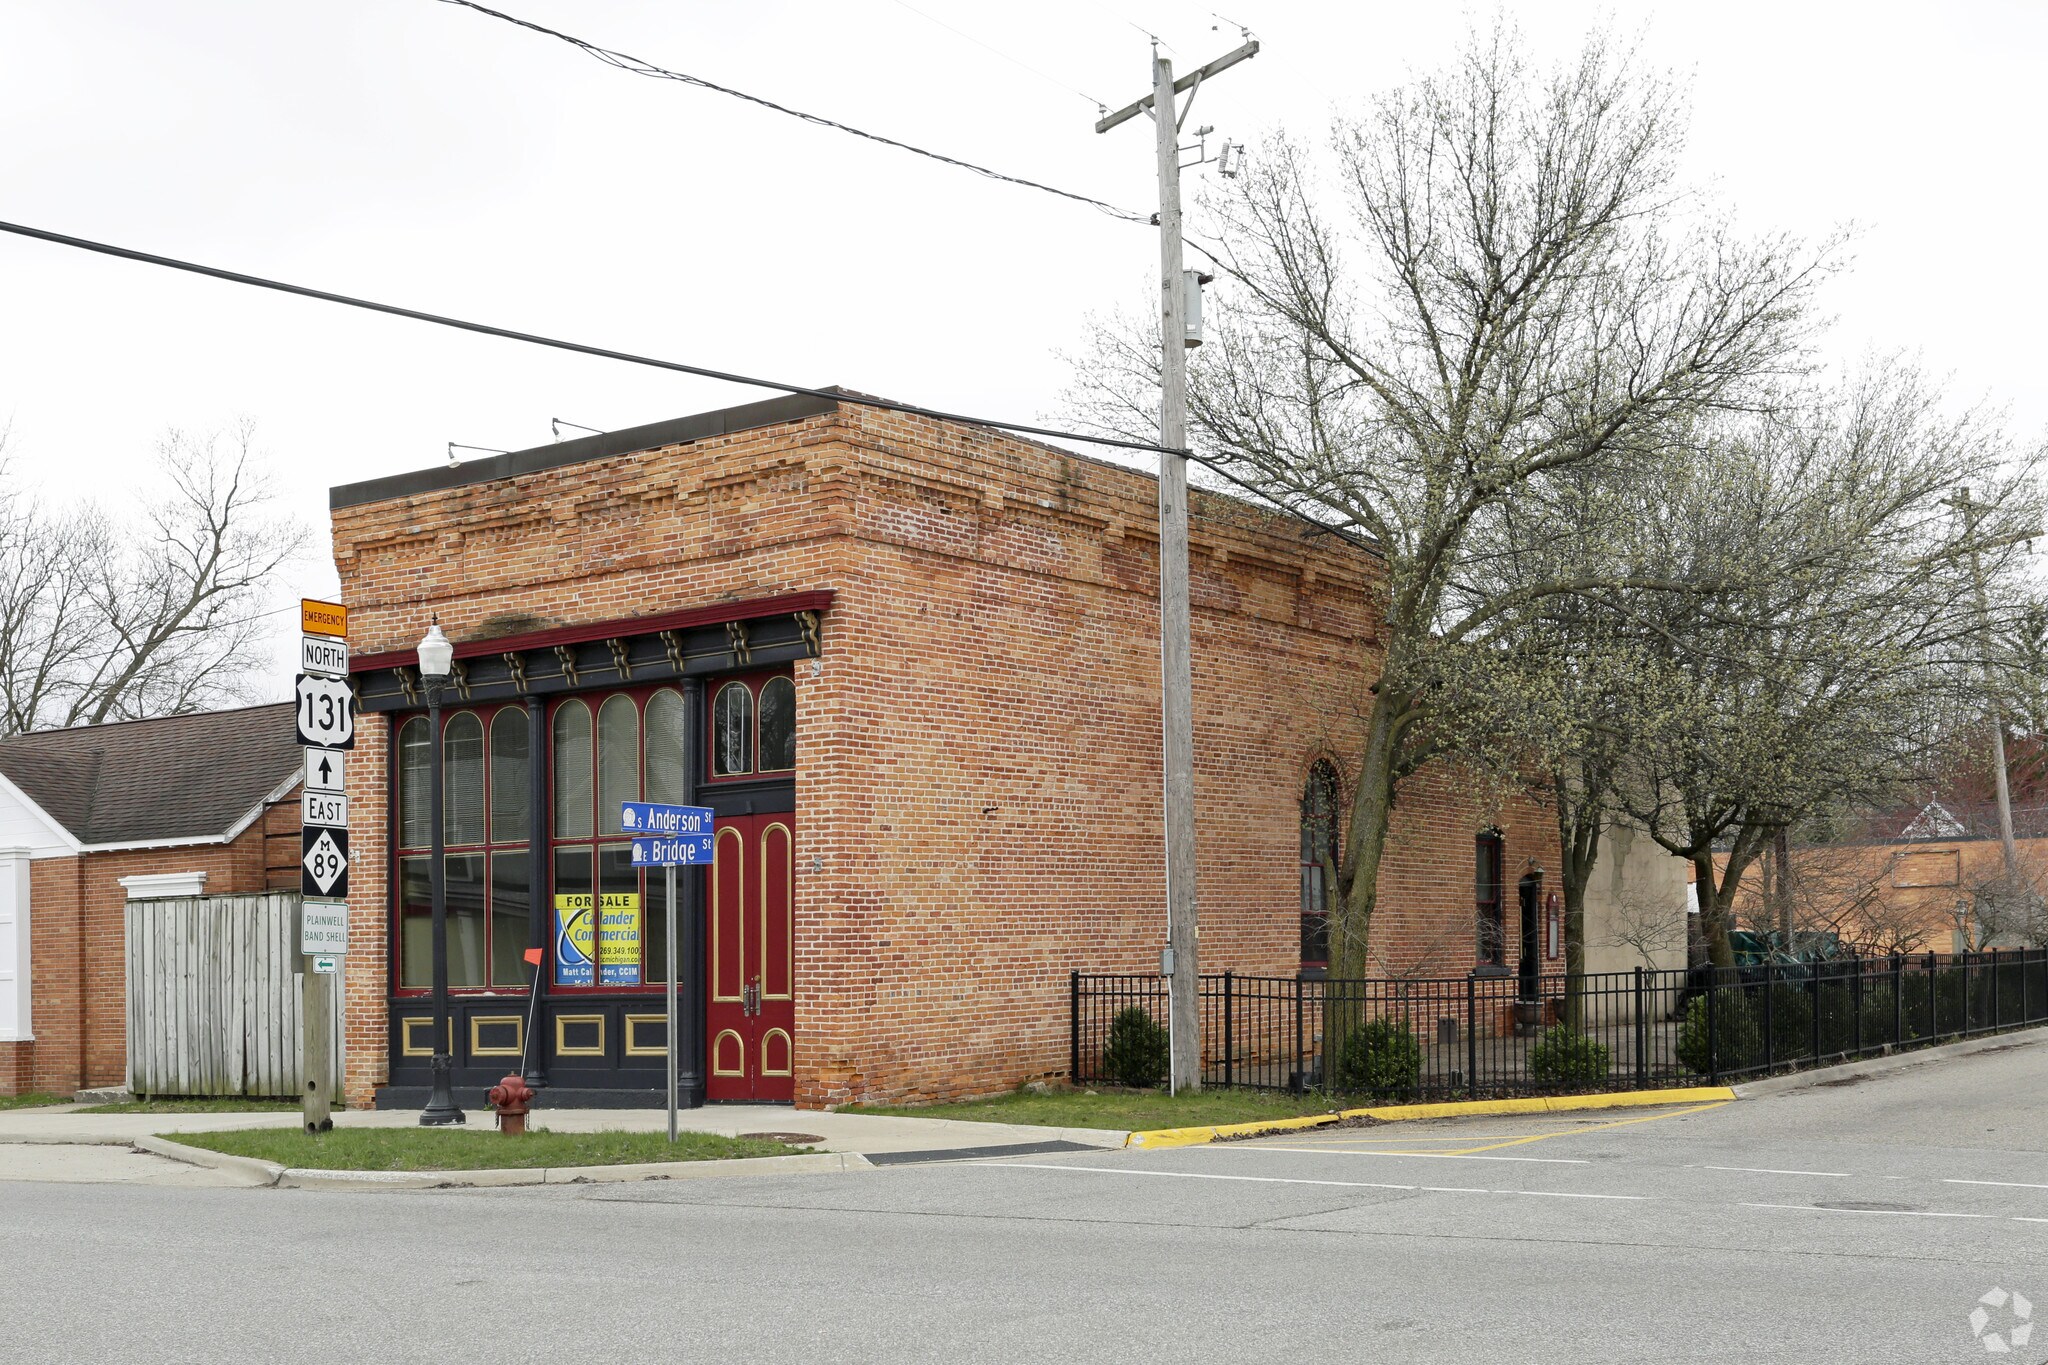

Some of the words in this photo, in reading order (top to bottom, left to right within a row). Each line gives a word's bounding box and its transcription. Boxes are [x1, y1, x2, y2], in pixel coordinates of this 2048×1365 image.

[304, 610, 345, 627] EMERGENCY
[306, 644, 345, 669] NORTH
[306, 692, 345, 732] 131
[309, 797, 342, 821] EAST
[637, 816, 643, 829] S
[647, 807, 701, 832] Anderson
[704, 811, 712, 823] St
[320, 840, 331, 852] M
[643, 850, 648, 862] E
[652, 839, 696, 865] Bridge
[702, 838, 712, 850] St
[313, 853, 339, 879] 89
[566, 896, 592, 907] FOR
[599, 895, 630, 907] SALE
[306, 914, 345, 927] PLAINWELL
[582, 910, 635, 926] Calander
[304, 930, 324, 942] BAND
[326, 931, 346, 943] SHELL
[562, 967, 579, 976] Matt
[618, 967, 638, 976] CCIM
